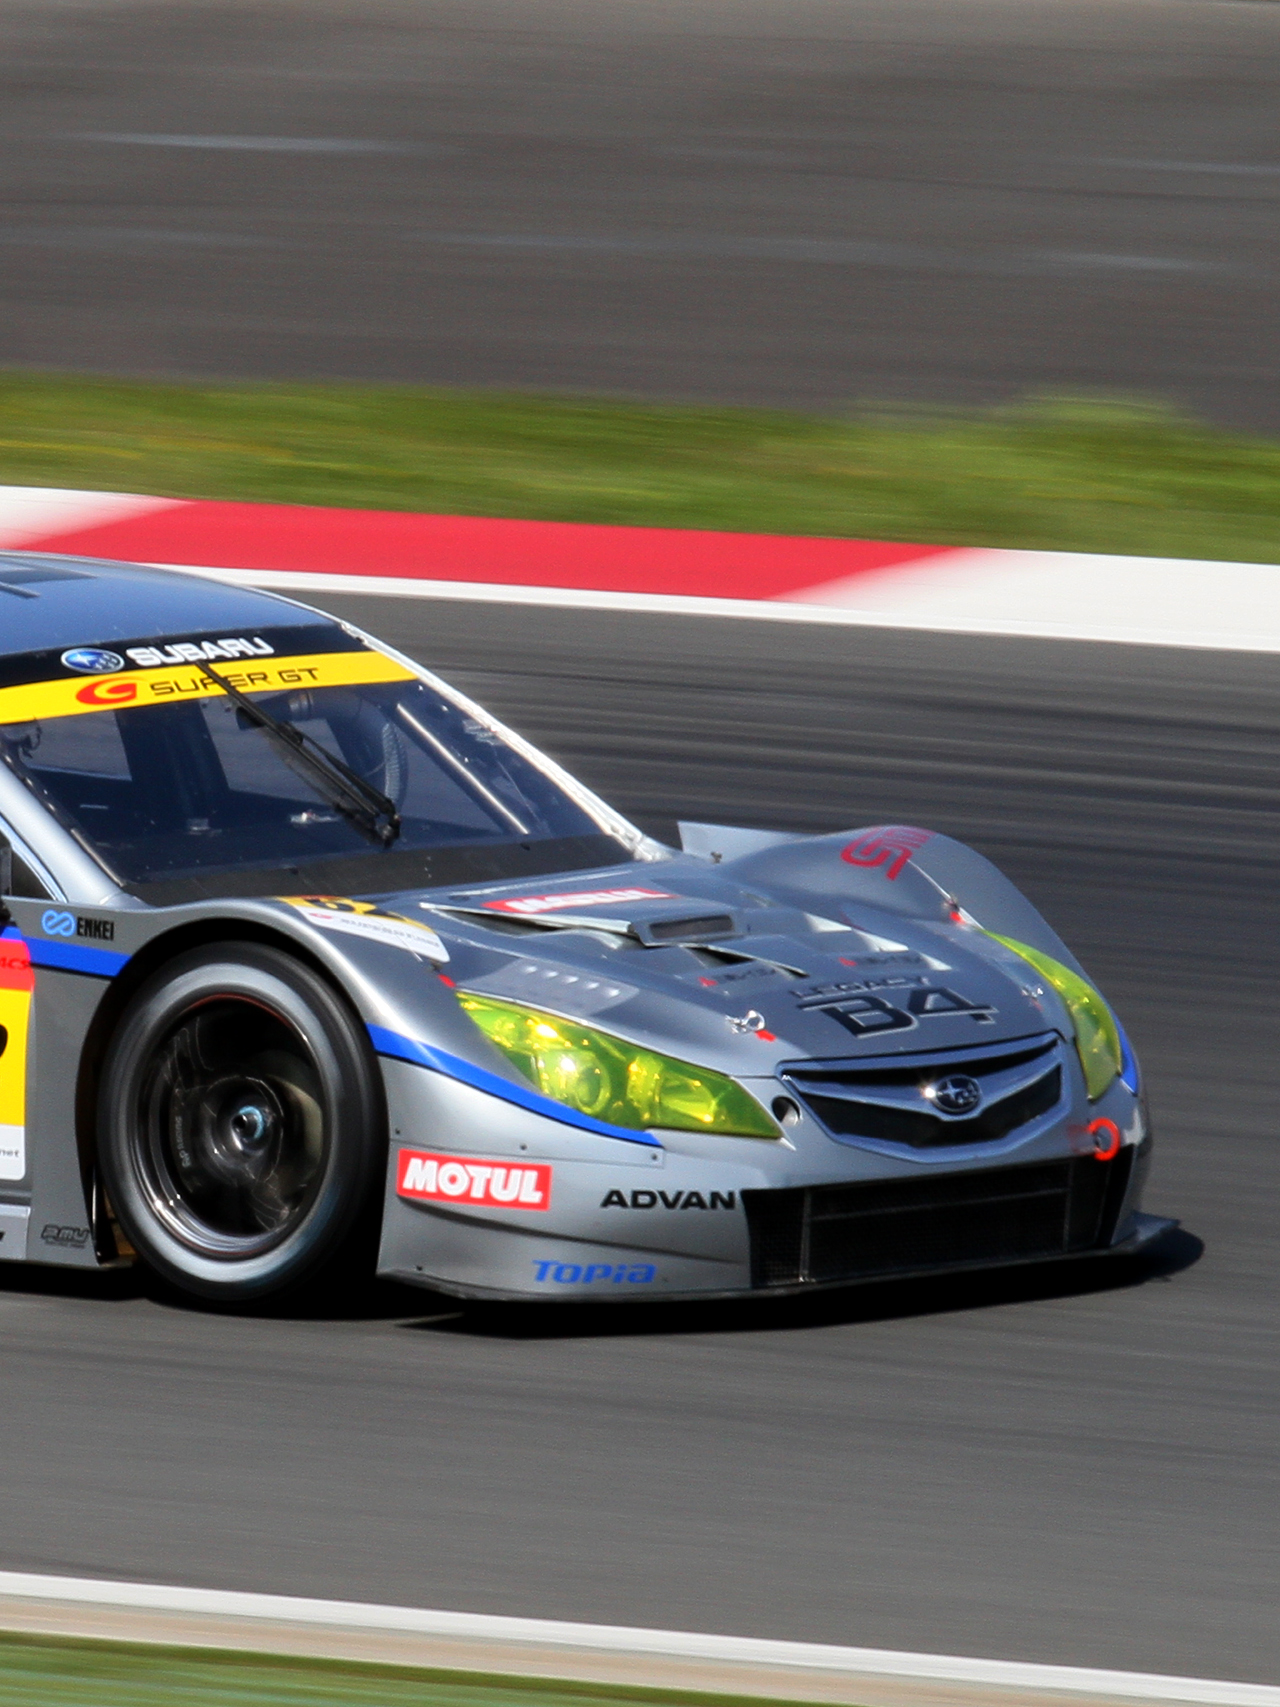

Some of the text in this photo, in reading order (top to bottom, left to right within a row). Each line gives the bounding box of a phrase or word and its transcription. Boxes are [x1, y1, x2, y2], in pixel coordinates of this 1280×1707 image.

[126, 636, 274, 667] SUBARU
[150, 671, 274, 696] SUPER
[278, 667, 320, 684] GT
[76, 916, 115, 941] ENKEI
[796, 986, 1000, 1040] B4
[403, 1157, 544, 1204] MOTUL
[600, 1189, 736, 1211] ADVAN
